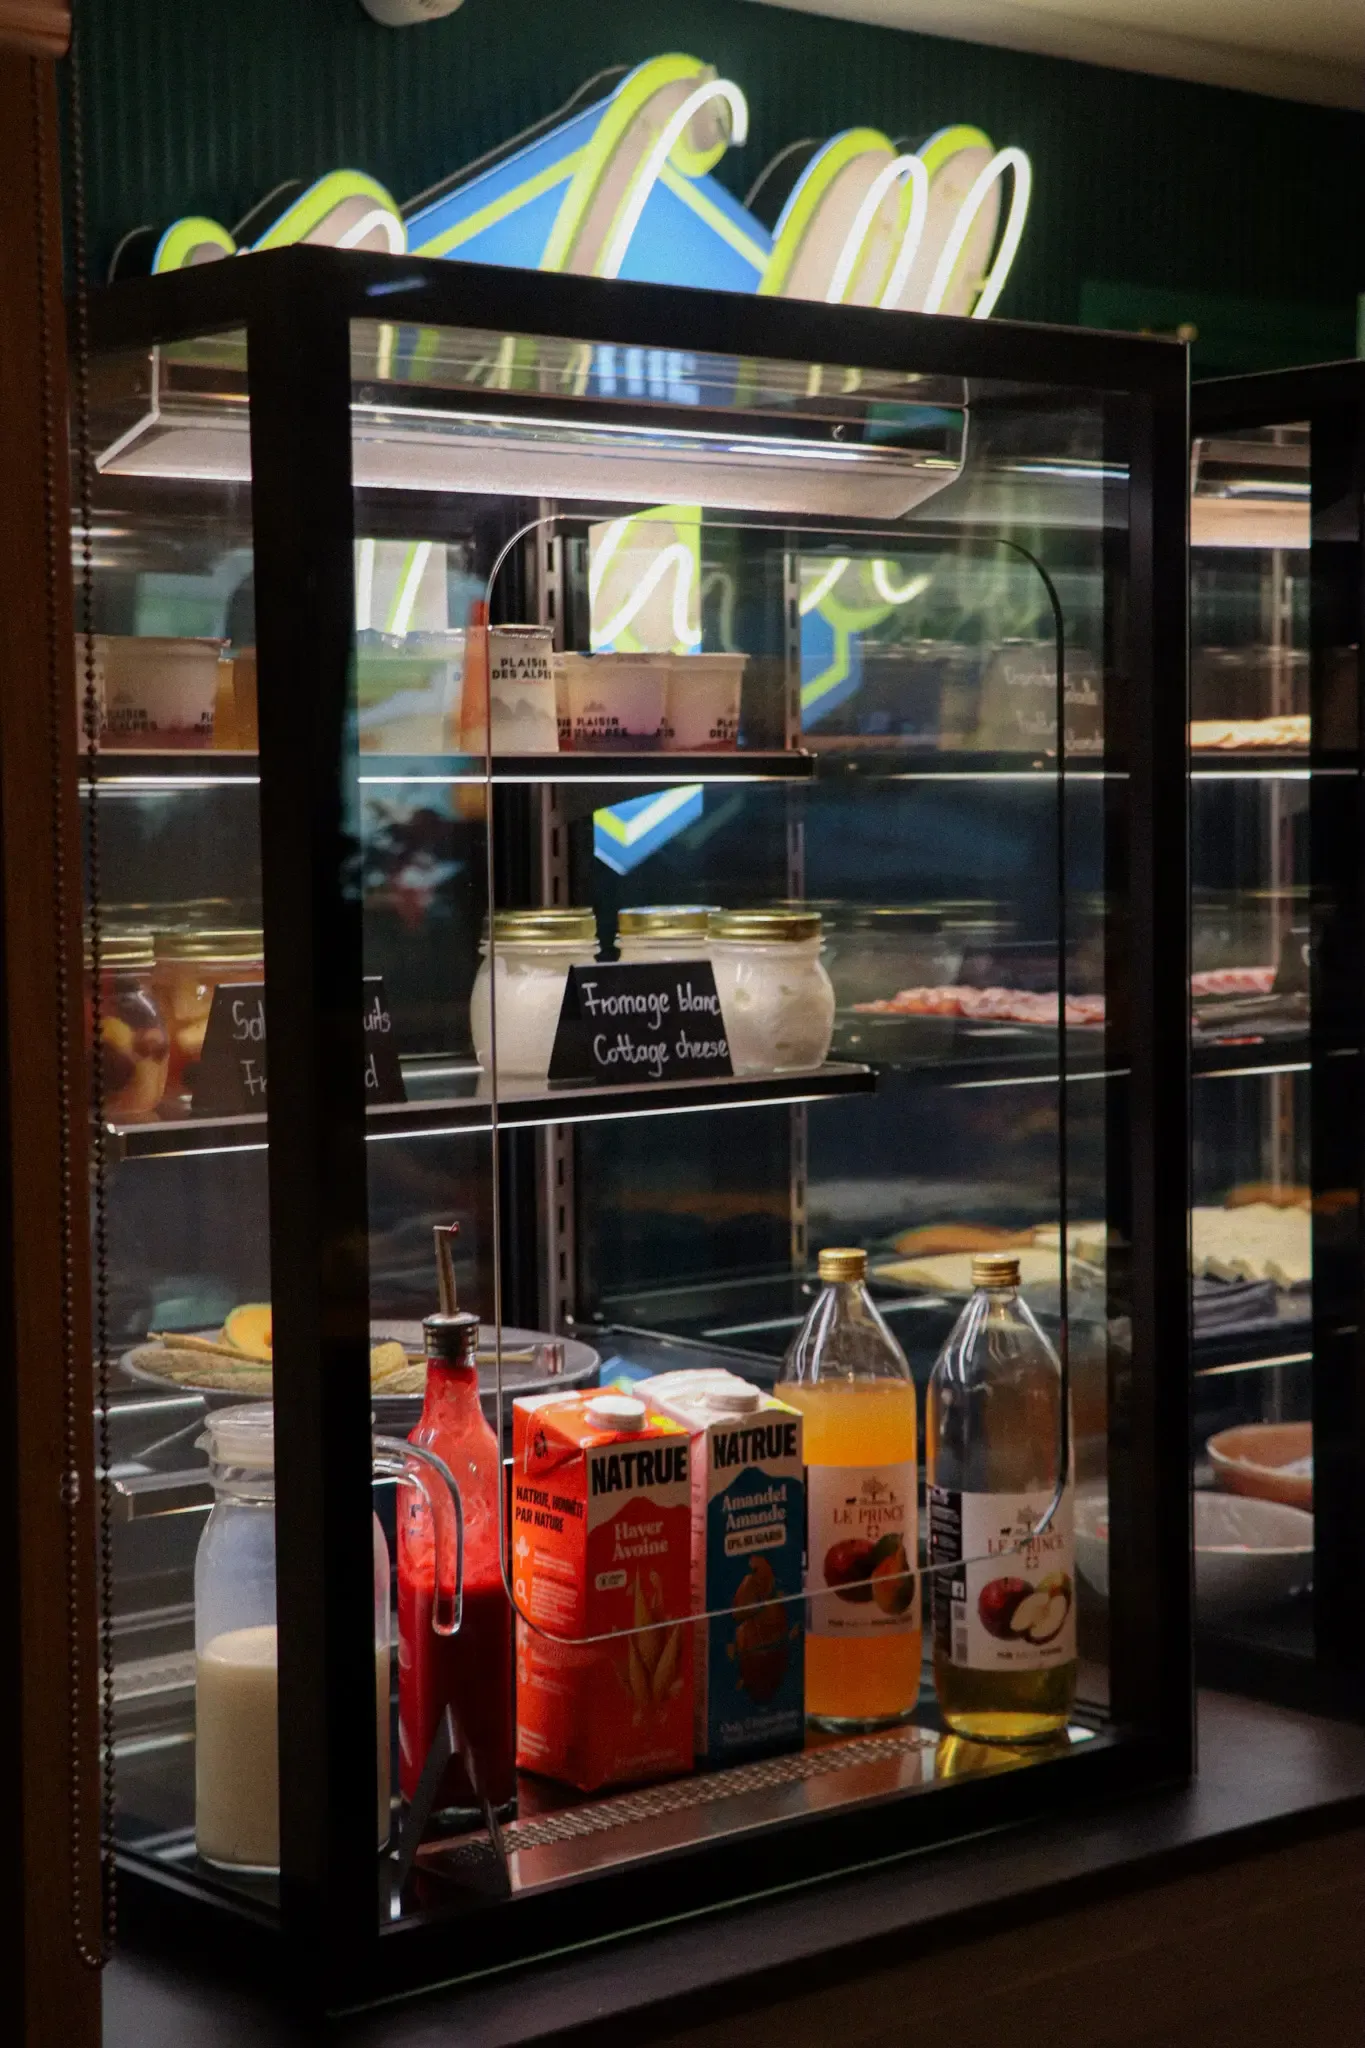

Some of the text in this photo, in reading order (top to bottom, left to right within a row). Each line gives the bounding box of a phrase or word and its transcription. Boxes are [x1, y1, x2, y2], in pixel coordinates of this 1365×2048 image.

[492, 669, 516, 681] DES
[581, 982, 670, 1030] Fromage
[593, 1030, 730, 1078] Cottage cheese
[712, 1423, 798, 1470] NATRUE
[590, 1446, 688, 1497] NATRUE
[515, 1485, 551, 1512] NATRUE,
[722, 1483, 788, 1512] Amandel
[515, 1506, 565, 1533] PAR NATURE
[725, 1506, 787, 1532] Amande
[833, 1508, 853, 1525] LE
[611, 1539, 669, 1562] Avoine
